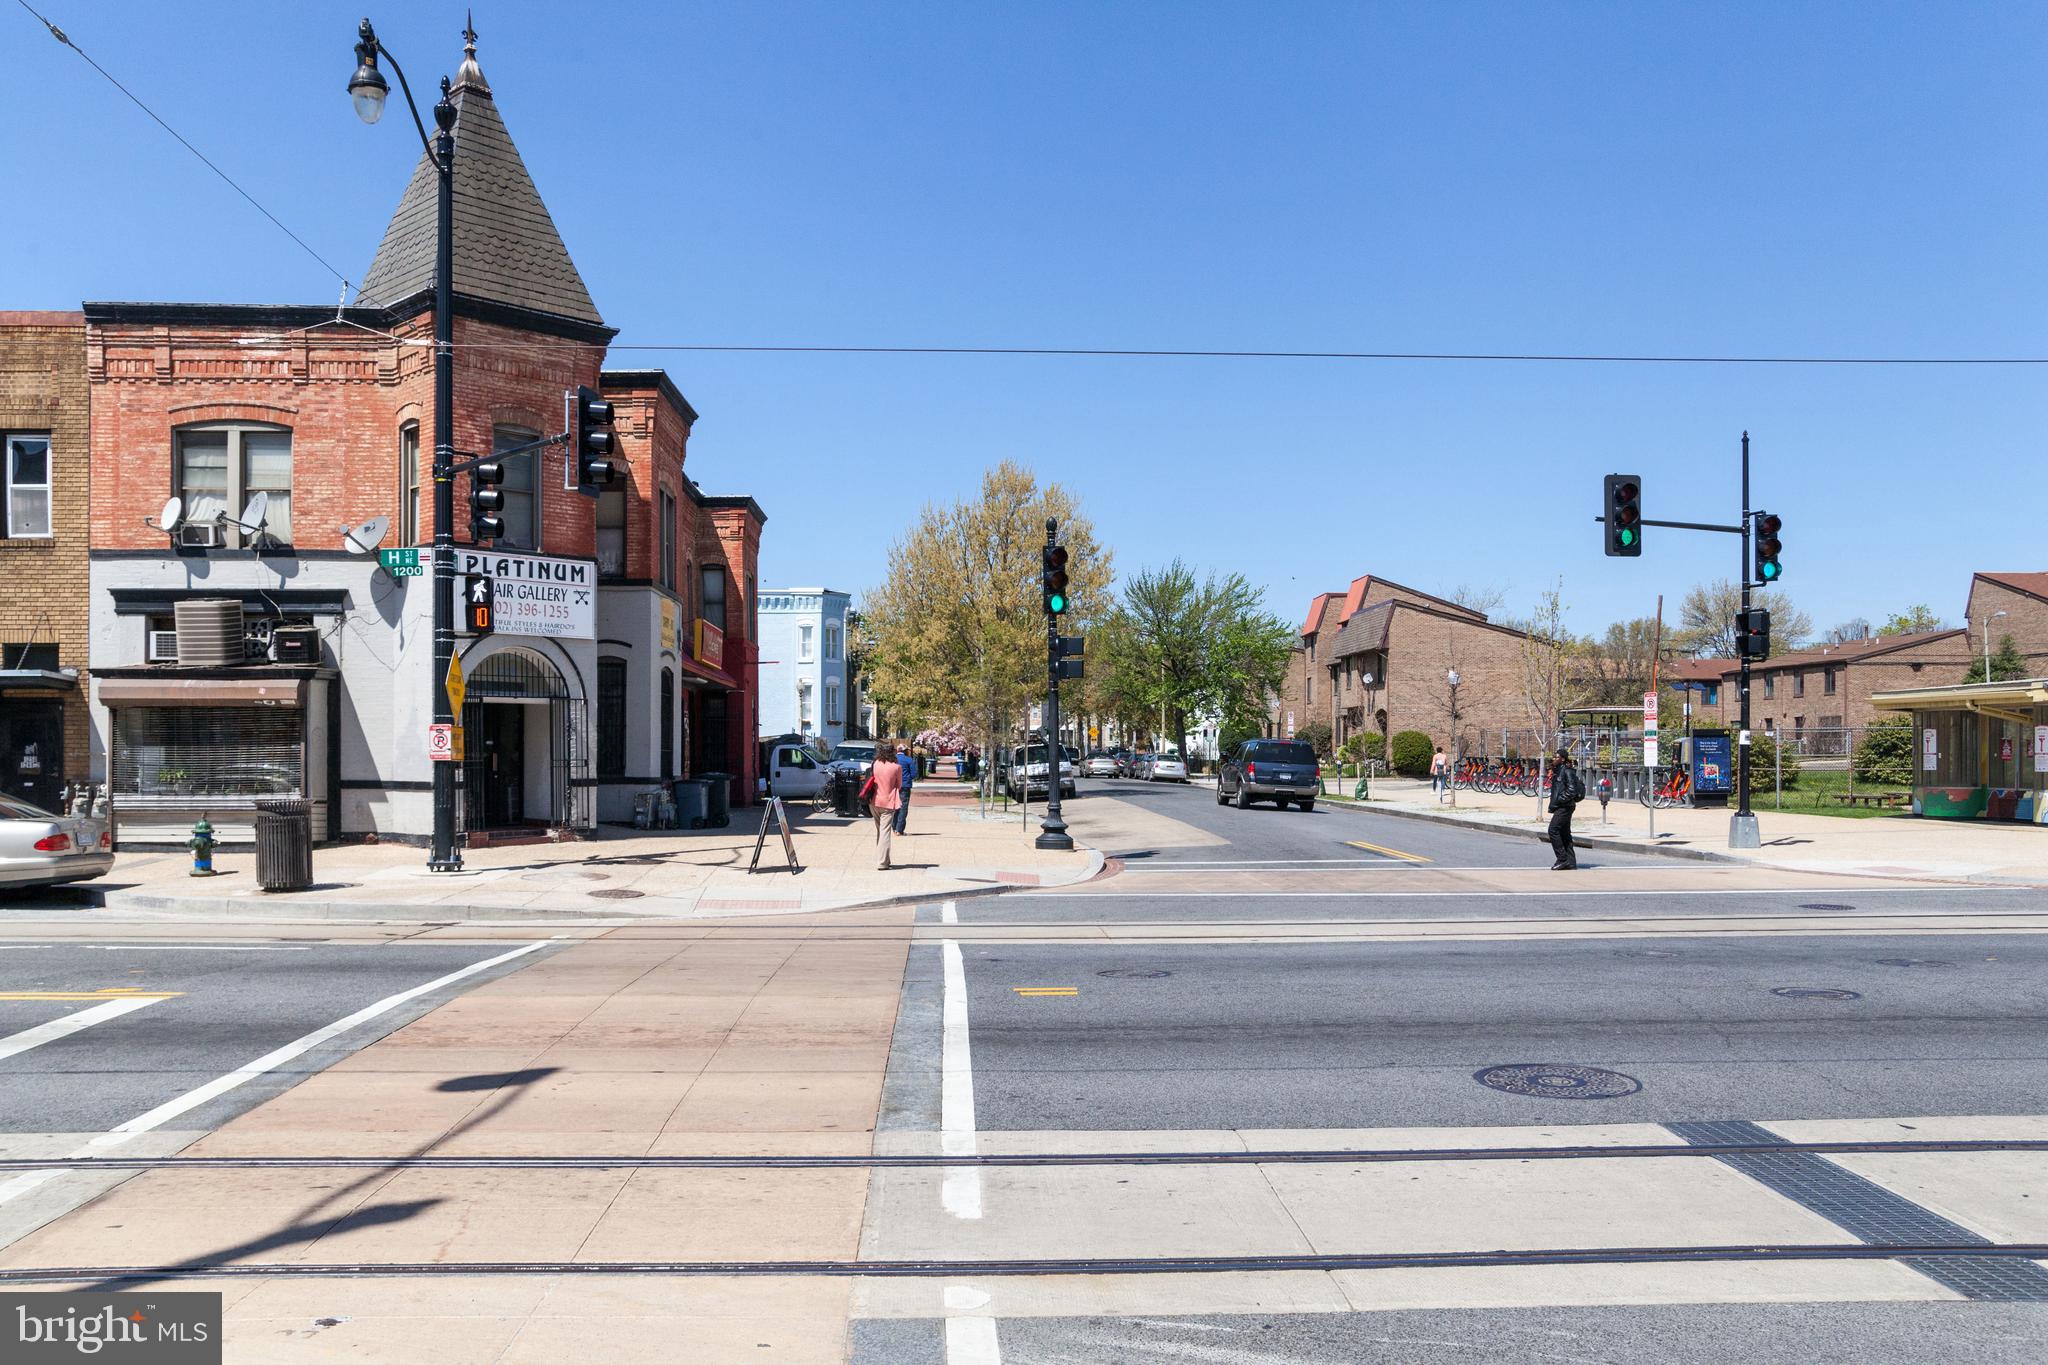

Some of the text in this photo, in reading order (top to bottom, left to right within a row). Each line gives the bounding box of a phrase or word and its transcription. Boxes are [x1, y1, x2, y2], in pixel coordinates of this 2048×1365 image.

[388, 551, 400, 564] H
[393, 566, 422, 576] 1200
[466, 555, 585, 583] PLATINUM
[494, 583, 568, 602] AIR GALLERY
[476, 607, 488, 627] 10
[494, 601, 569, 619] 02) 396-1255
